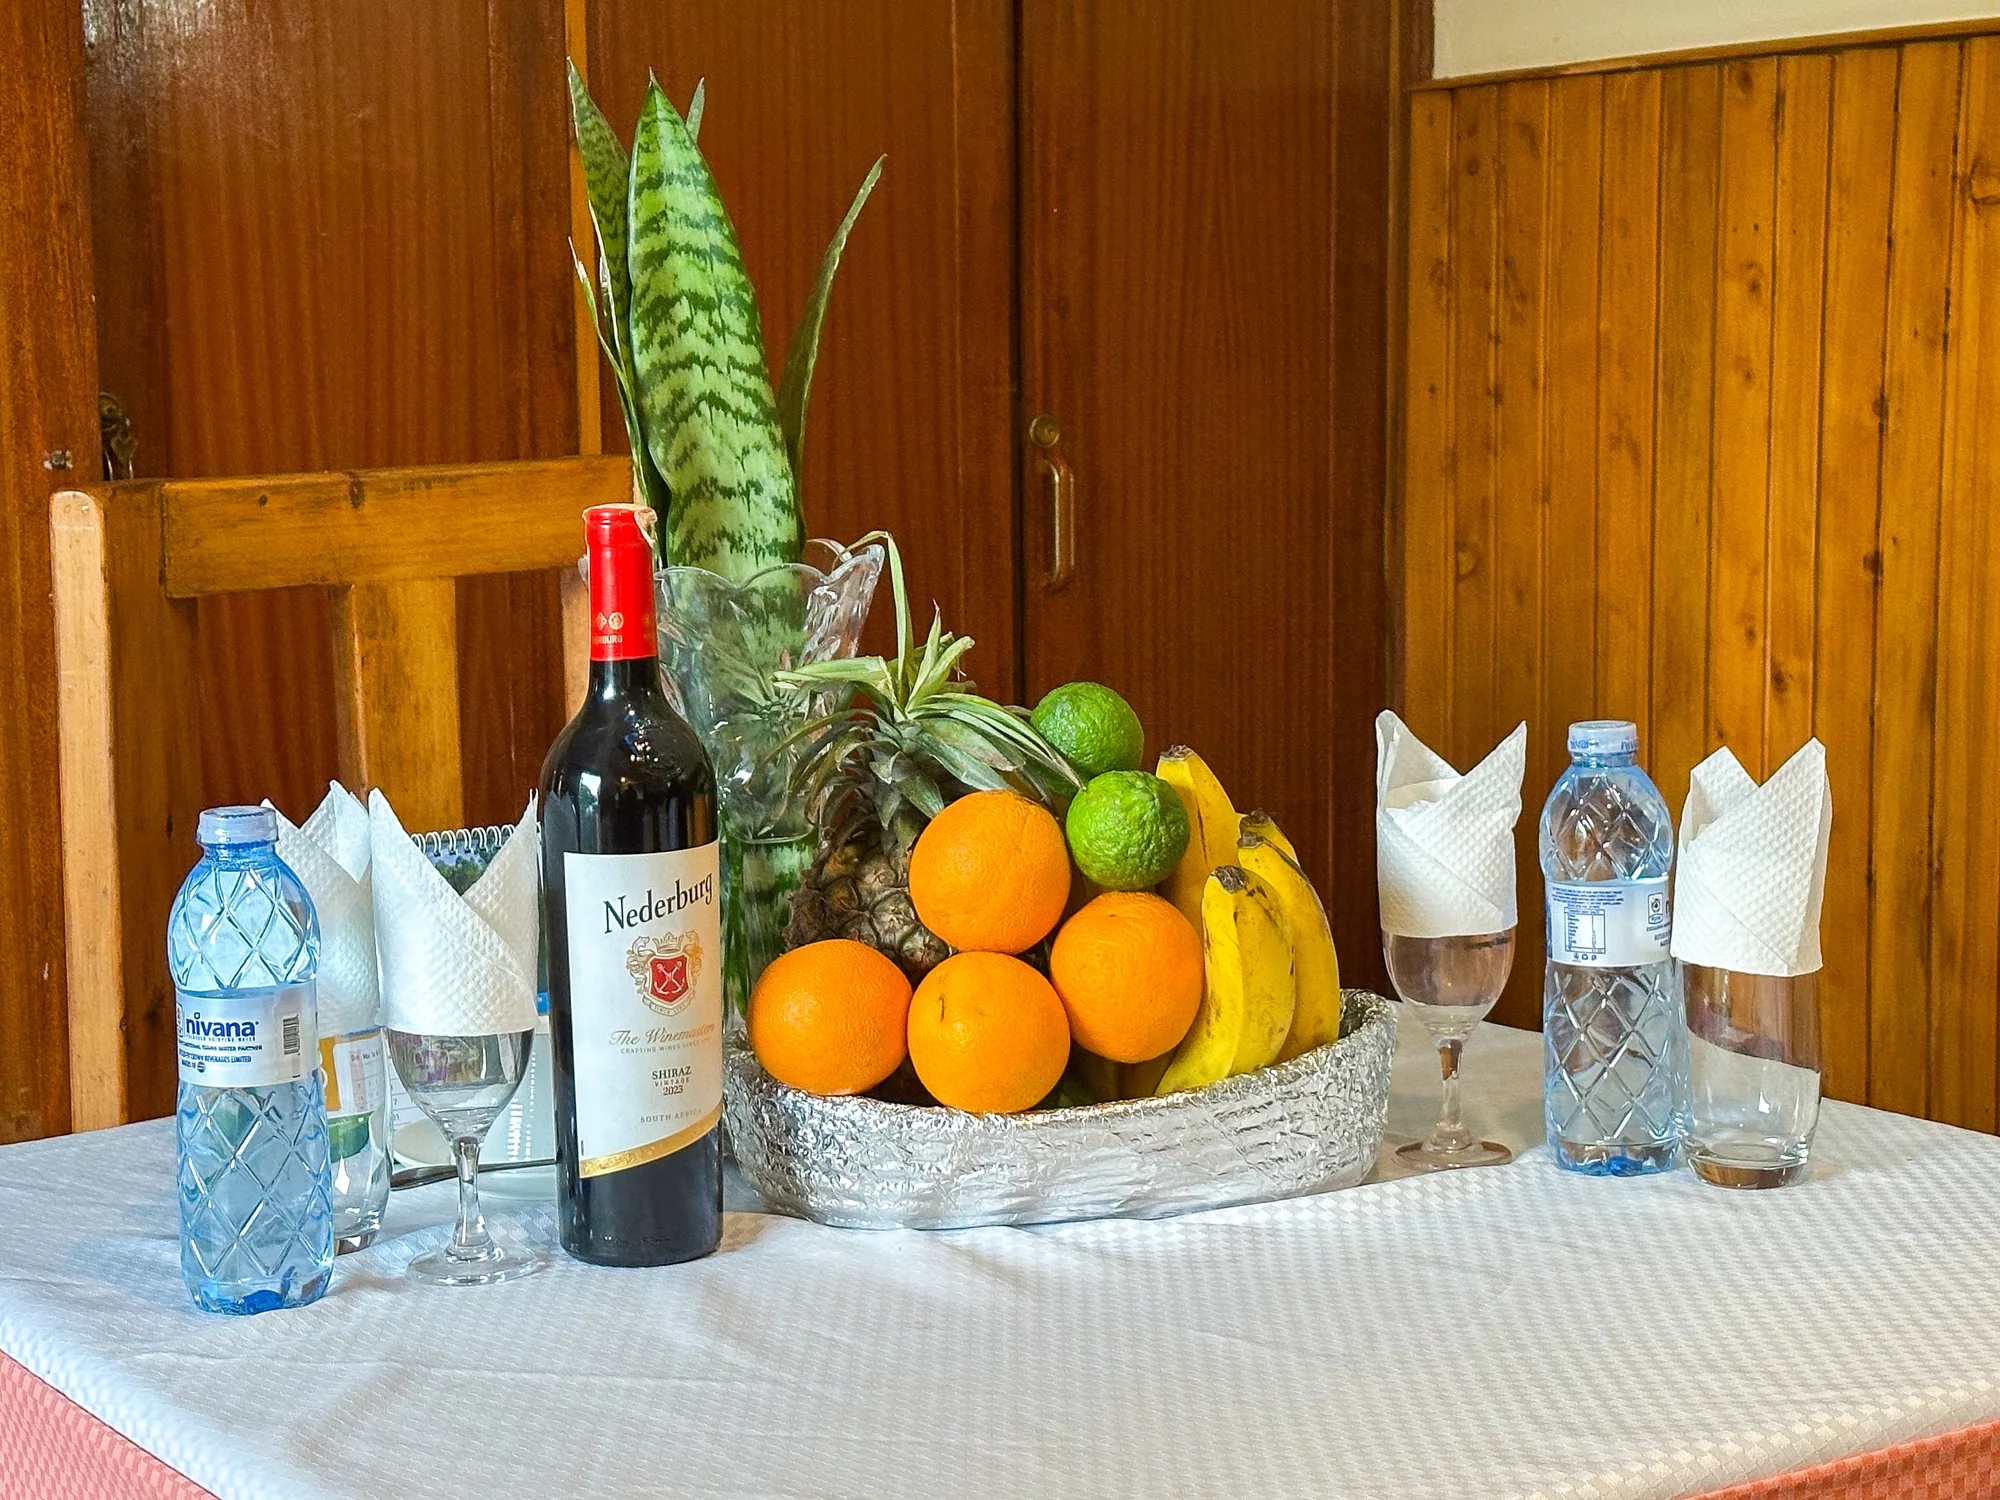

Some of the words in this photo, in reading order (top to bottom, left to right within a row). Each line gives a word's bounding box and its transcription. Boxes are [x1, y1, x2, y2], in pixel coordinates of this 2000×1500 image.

[603, 873, 713, 934] Nederburg
[186, 1012, 255, 1037] nivana
[609, 1030, 641, 1046] The
[652, 1065, 692, 1080] SHIRAZ
[654, 1076, 690, 1088] VINTAGE
[663, 1085, 684, 1096] 2023
[640, 1114, 672, 1123] SOUTH
